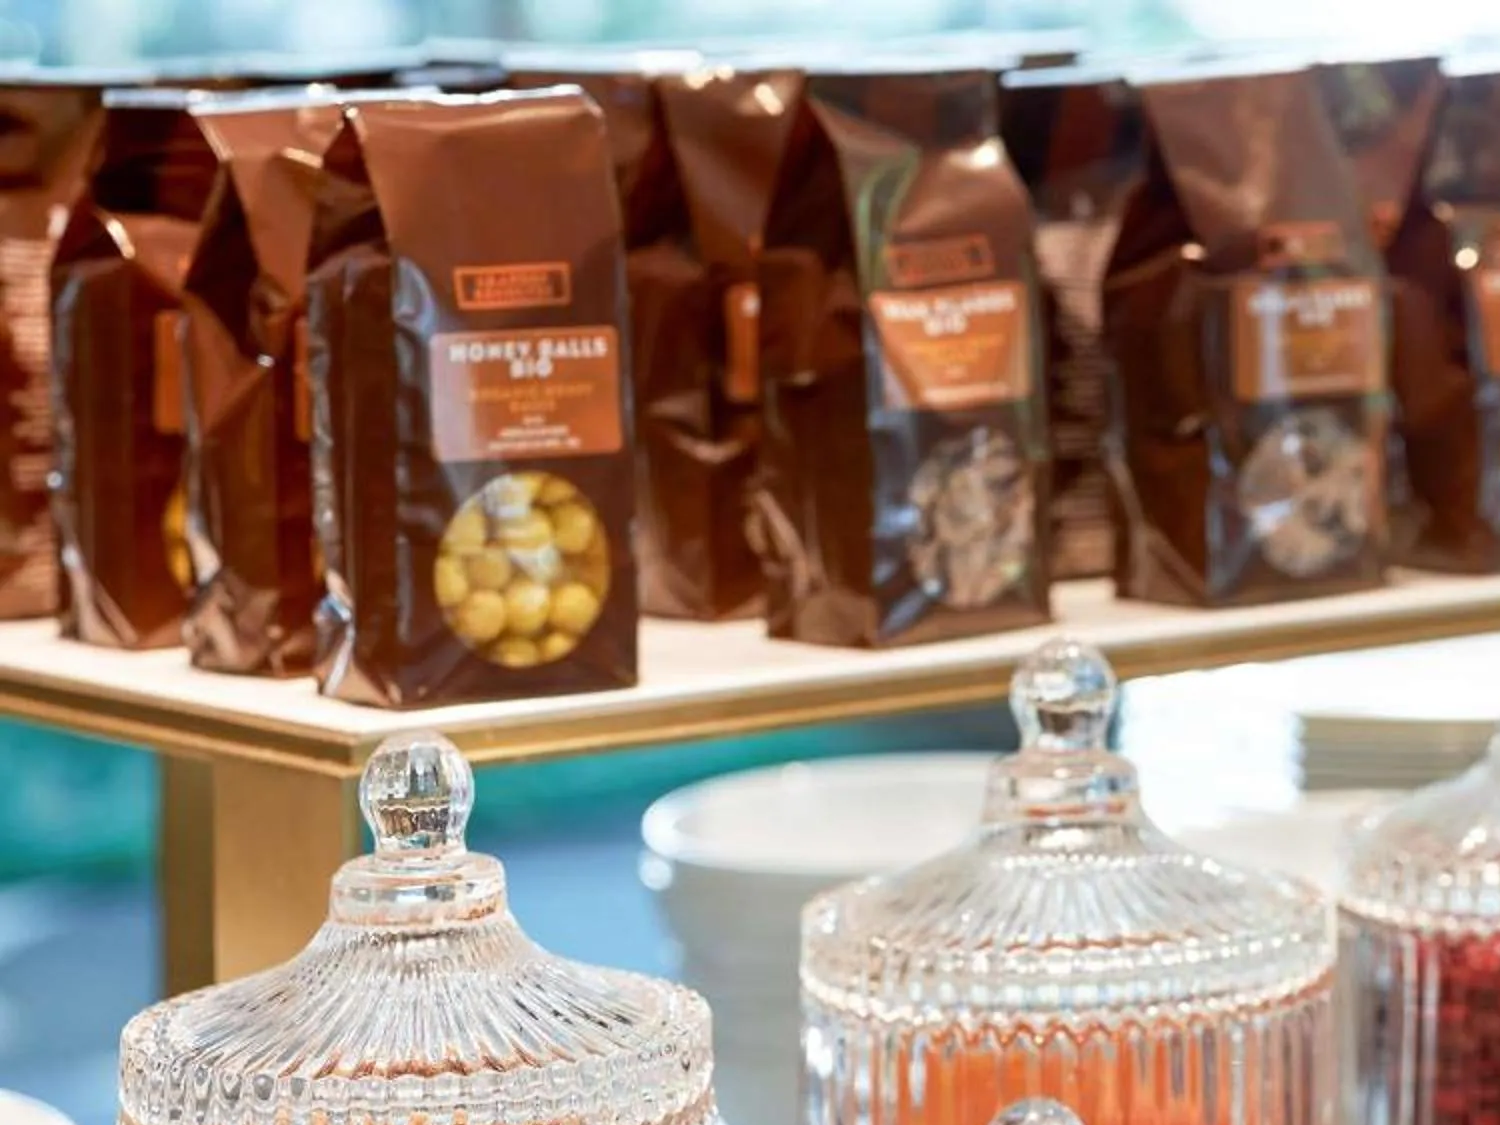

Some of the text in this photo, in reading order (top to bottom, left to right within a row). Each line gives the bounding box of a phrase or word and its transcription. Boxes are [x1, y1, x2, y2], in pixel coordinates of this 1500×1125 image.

[449, 337, 608, 363] HONEY BALLS
[510, 357, 554, 379] BIO
